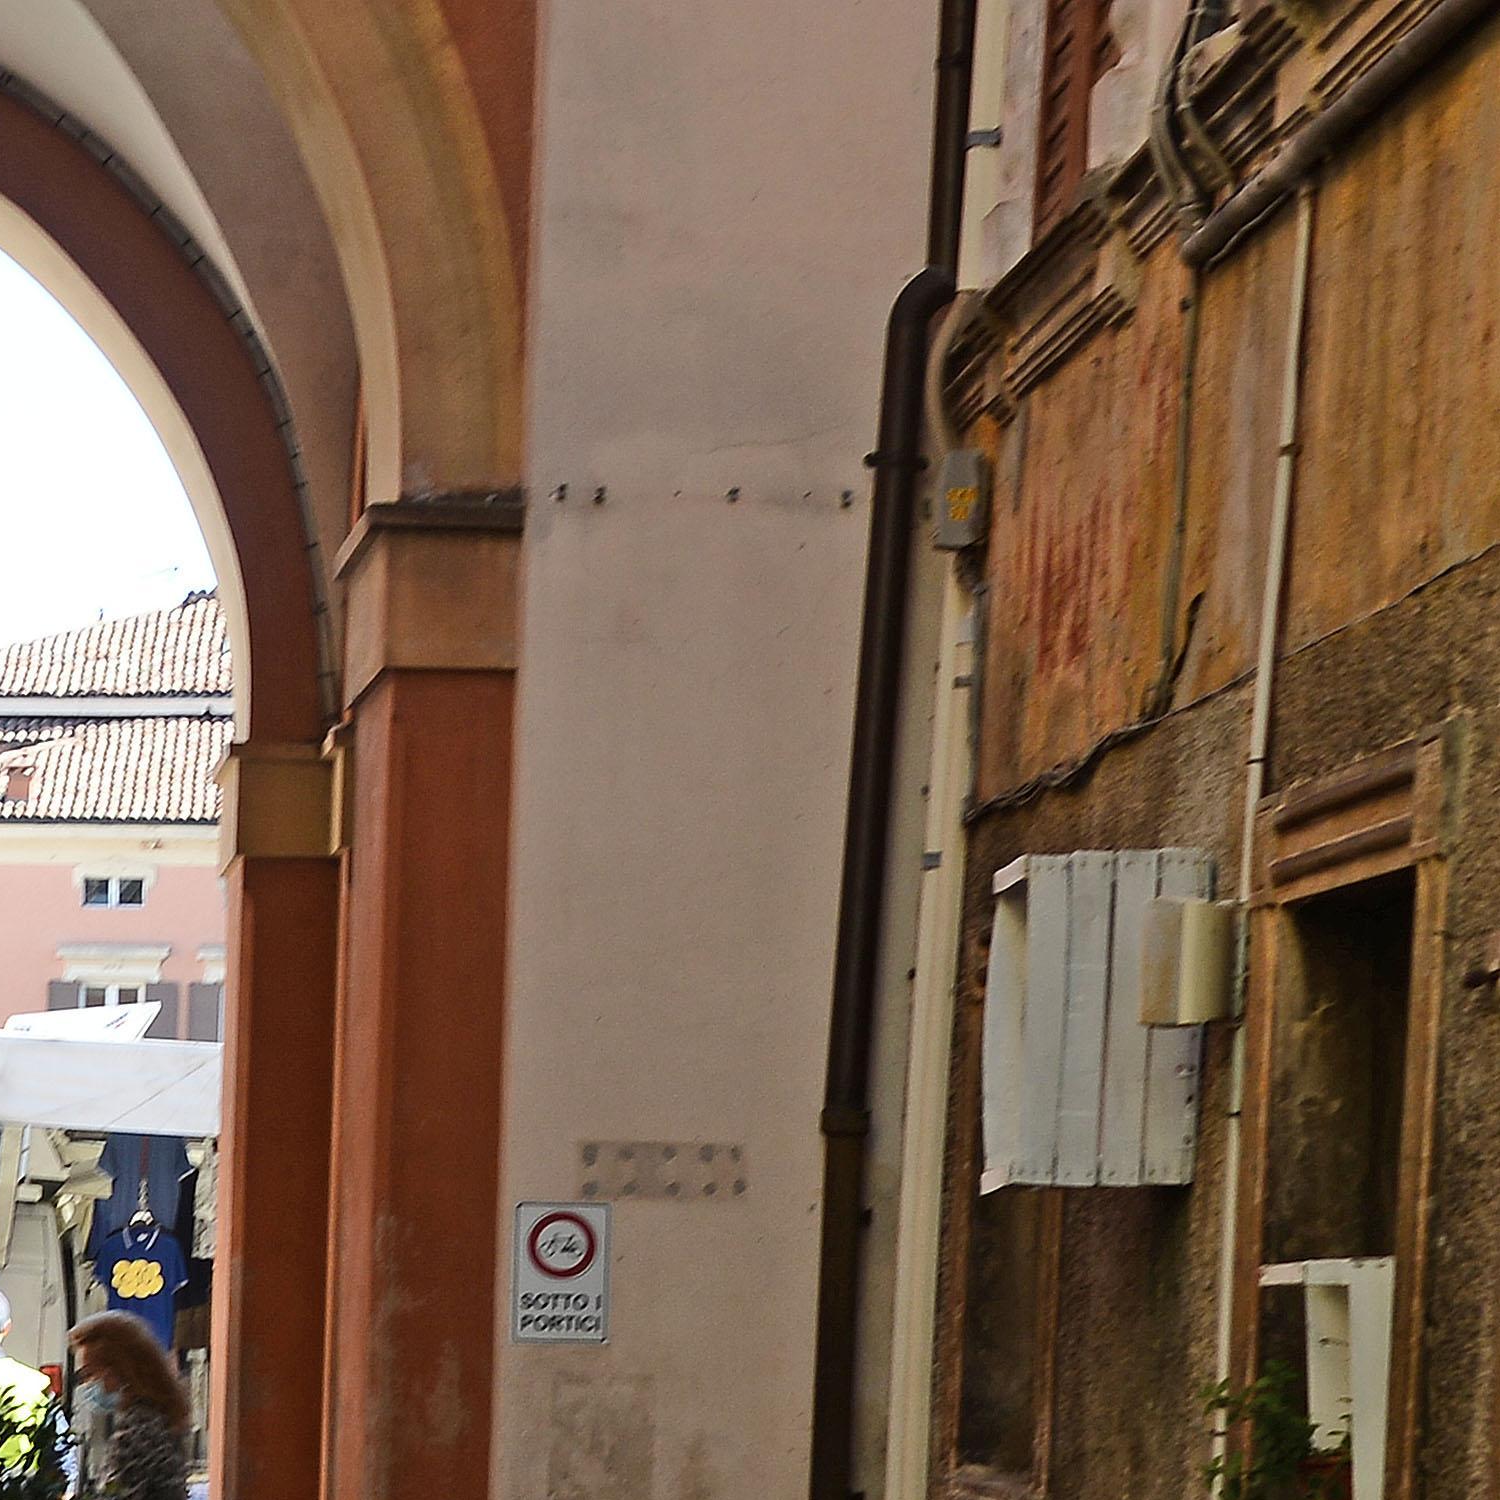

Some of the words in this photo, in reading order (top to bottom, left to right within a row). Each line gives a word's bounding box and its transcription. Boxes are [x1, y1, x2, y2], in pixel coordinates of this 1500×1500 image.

[520, 1292, 588, 1311] SOTTO
[595, 1293, 602, 1311] I
[520, 1314, 602, 1332] PORTICI
